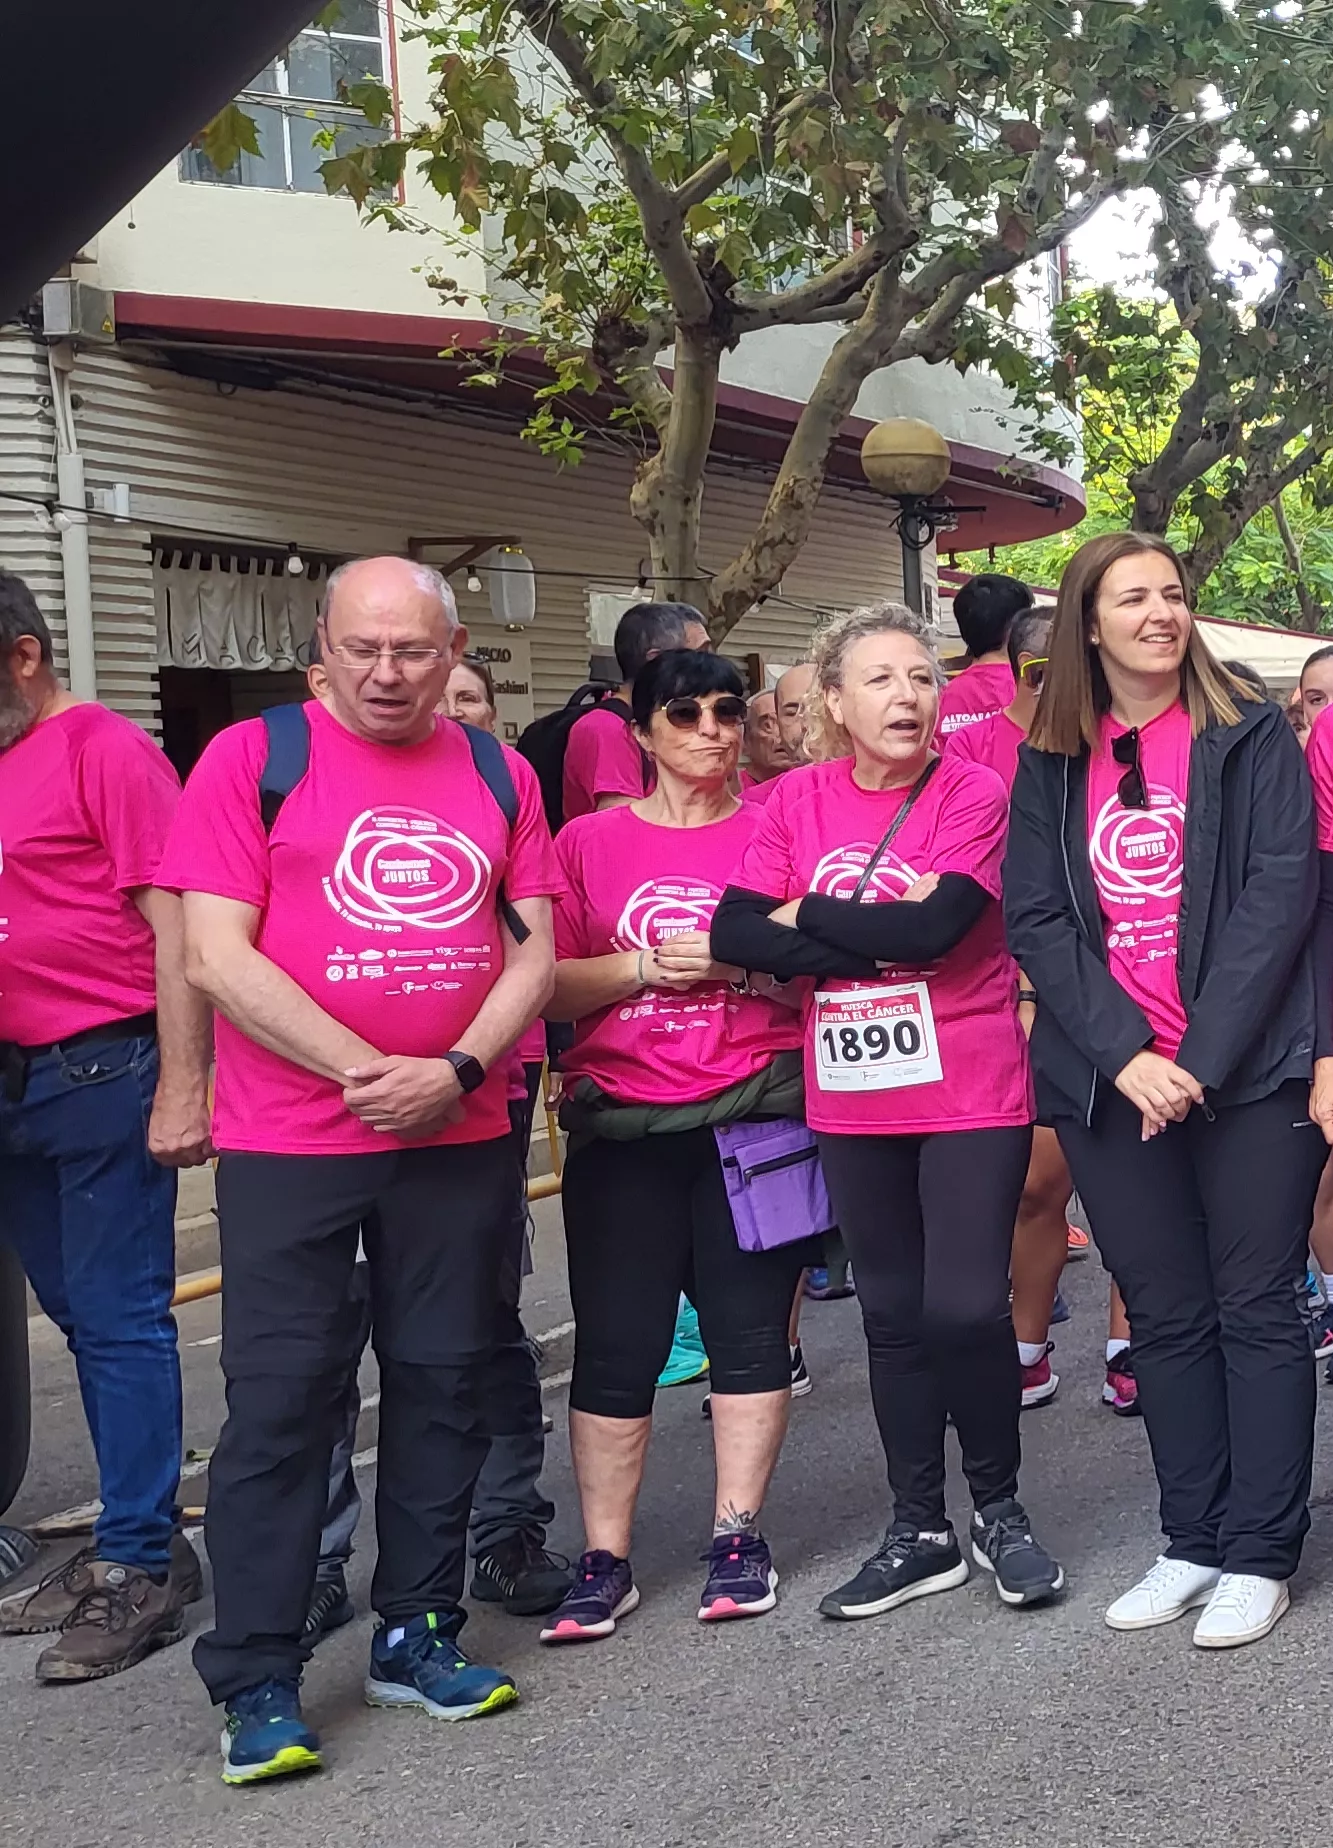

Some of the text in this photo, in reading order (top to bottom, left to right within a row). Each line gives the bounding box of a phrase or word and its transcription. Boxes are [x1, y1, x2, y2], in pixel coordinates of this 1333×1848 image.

[381, 869, 430, 884] JUNTOS
[852, 1011, 867, 1021] EL
[866, 1003, 915, 1019] CÁNCER
[822, 1019, 921, 1063] 1890
